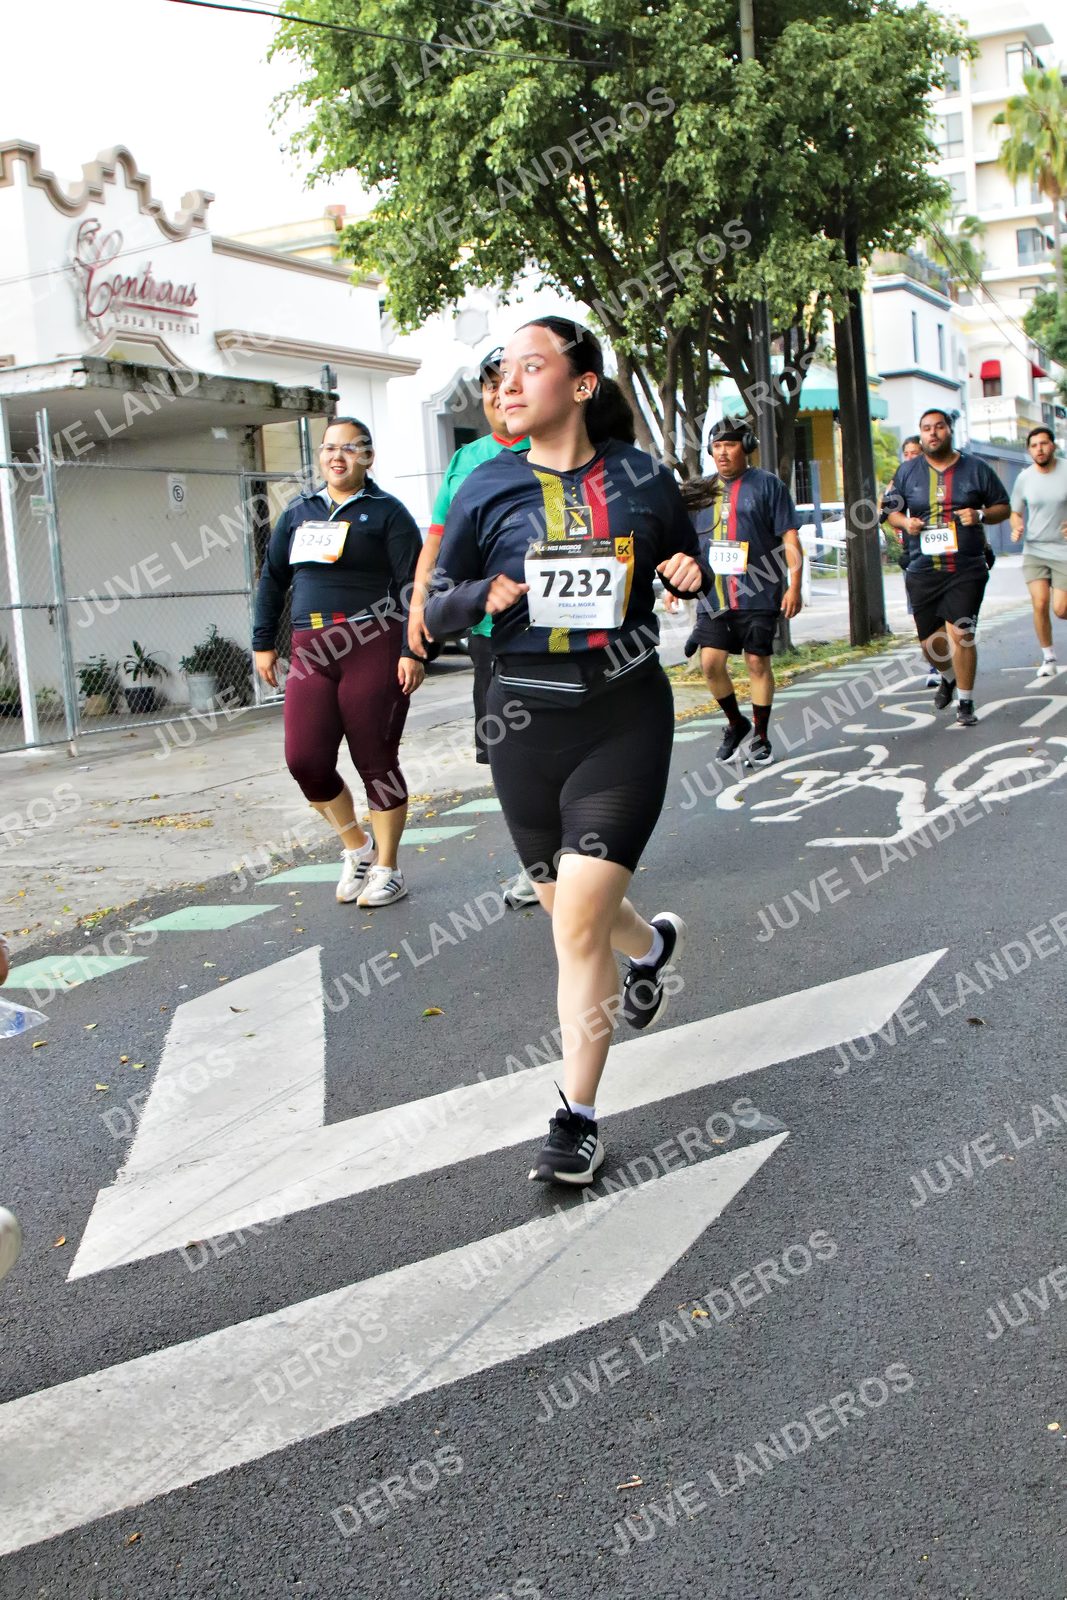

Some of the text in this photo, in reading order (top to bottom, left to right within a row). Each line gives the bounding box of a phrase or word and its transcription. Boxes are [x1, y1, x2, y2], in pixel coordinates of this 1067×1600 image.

[925, 532, 949, 544] 6998
[617, 544, 630, 555] 5K
[540, 569, 613, 597] 7232
